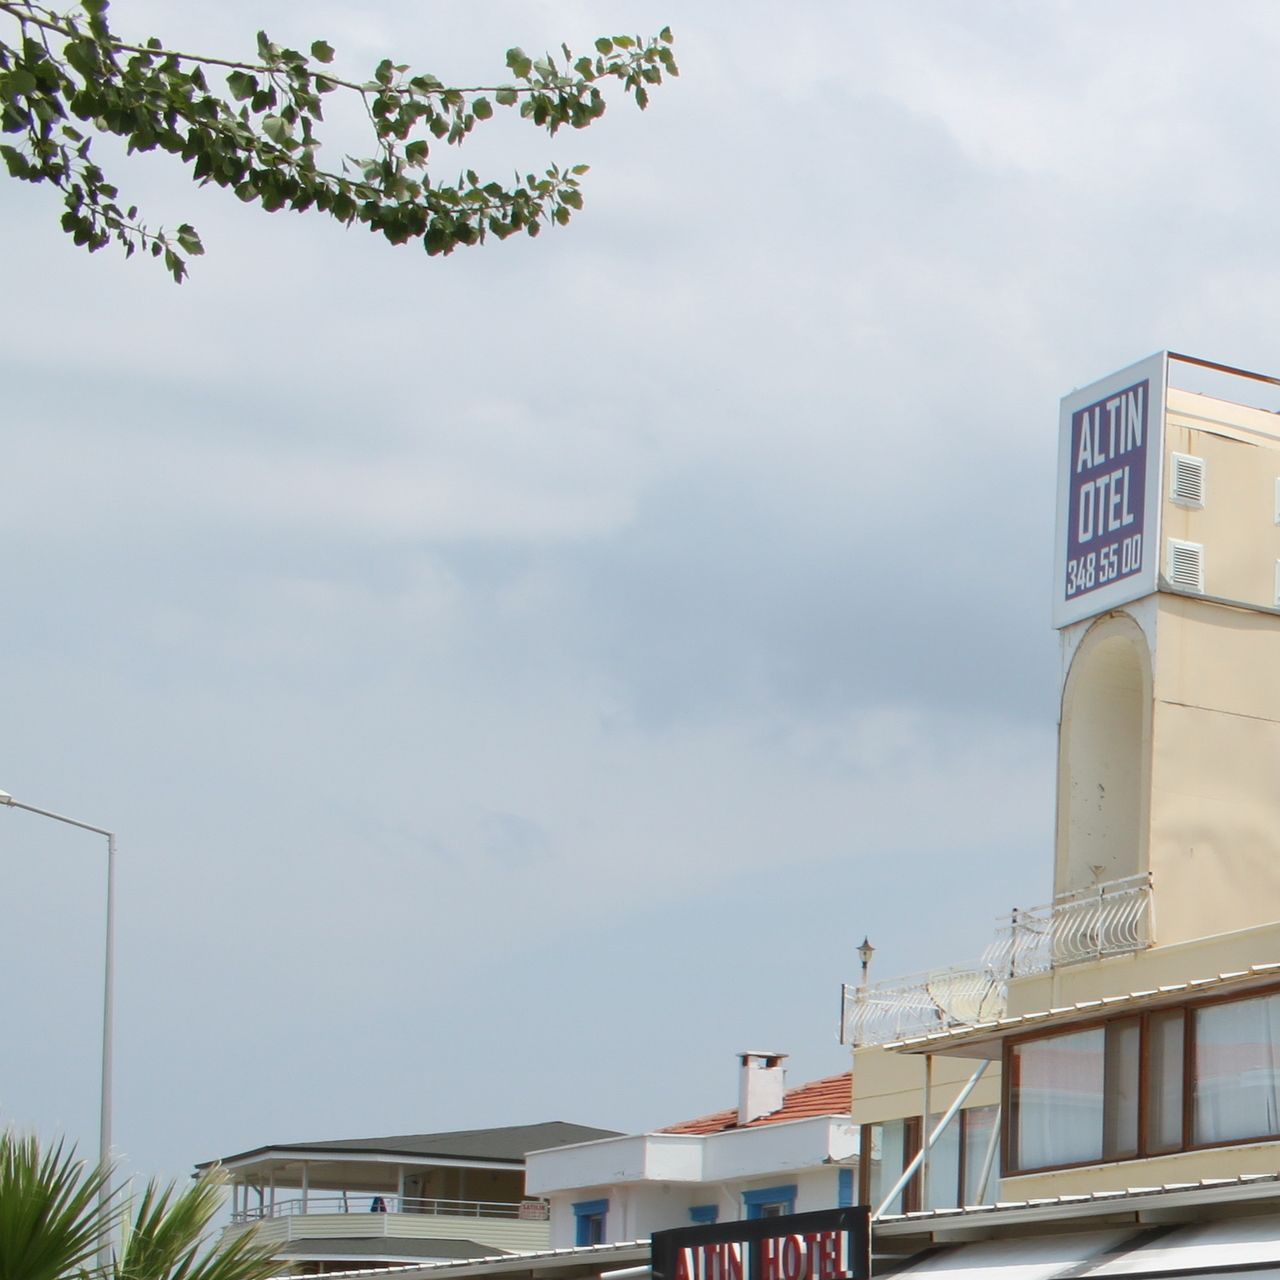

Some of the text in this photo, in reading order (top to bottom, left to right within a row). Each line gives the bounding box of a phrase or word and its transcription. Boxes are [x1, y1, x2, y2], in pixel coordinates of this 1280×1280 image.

[1077, 386, 1143, 473] ALTIN
[1078, 466, 1134, 544] OTEL
[1067, 533, 1142, 595] 348 55 00
